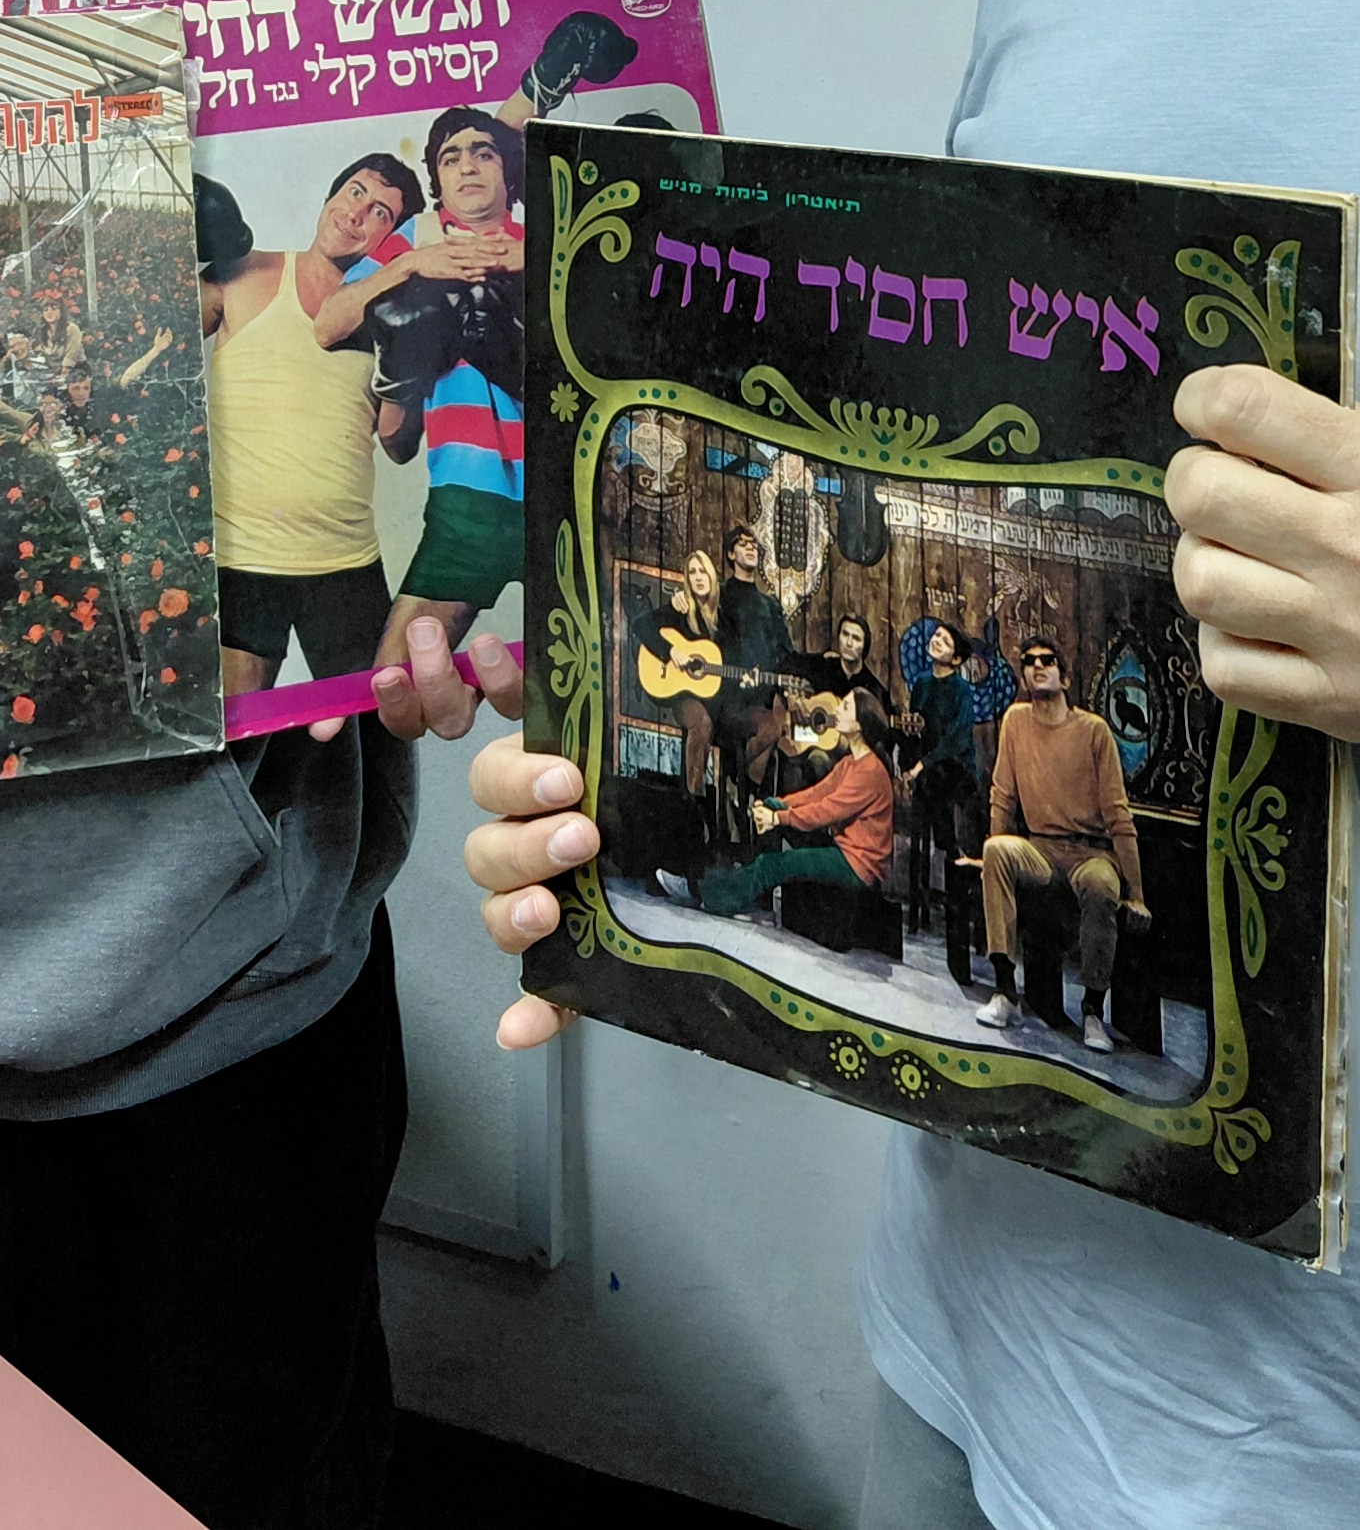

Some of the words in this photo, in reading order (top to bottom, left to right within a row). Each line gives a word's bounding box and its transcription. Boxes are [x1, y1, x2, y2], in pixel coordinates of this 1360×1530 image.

[195, 56, 256, 109] חל
[263, 81, 299, 103] נגד
[303, 43, 376, 107] קלי
[388, 40, 499, 93] קסיוס
[715, 185, 769, 202] בימות
[785, 192, 861, 213] תיאטרון
[650, 231, 770, 322] היה
[797, 255, 969, 348] חסיד
[1008, 277, 1160, 376] איש
